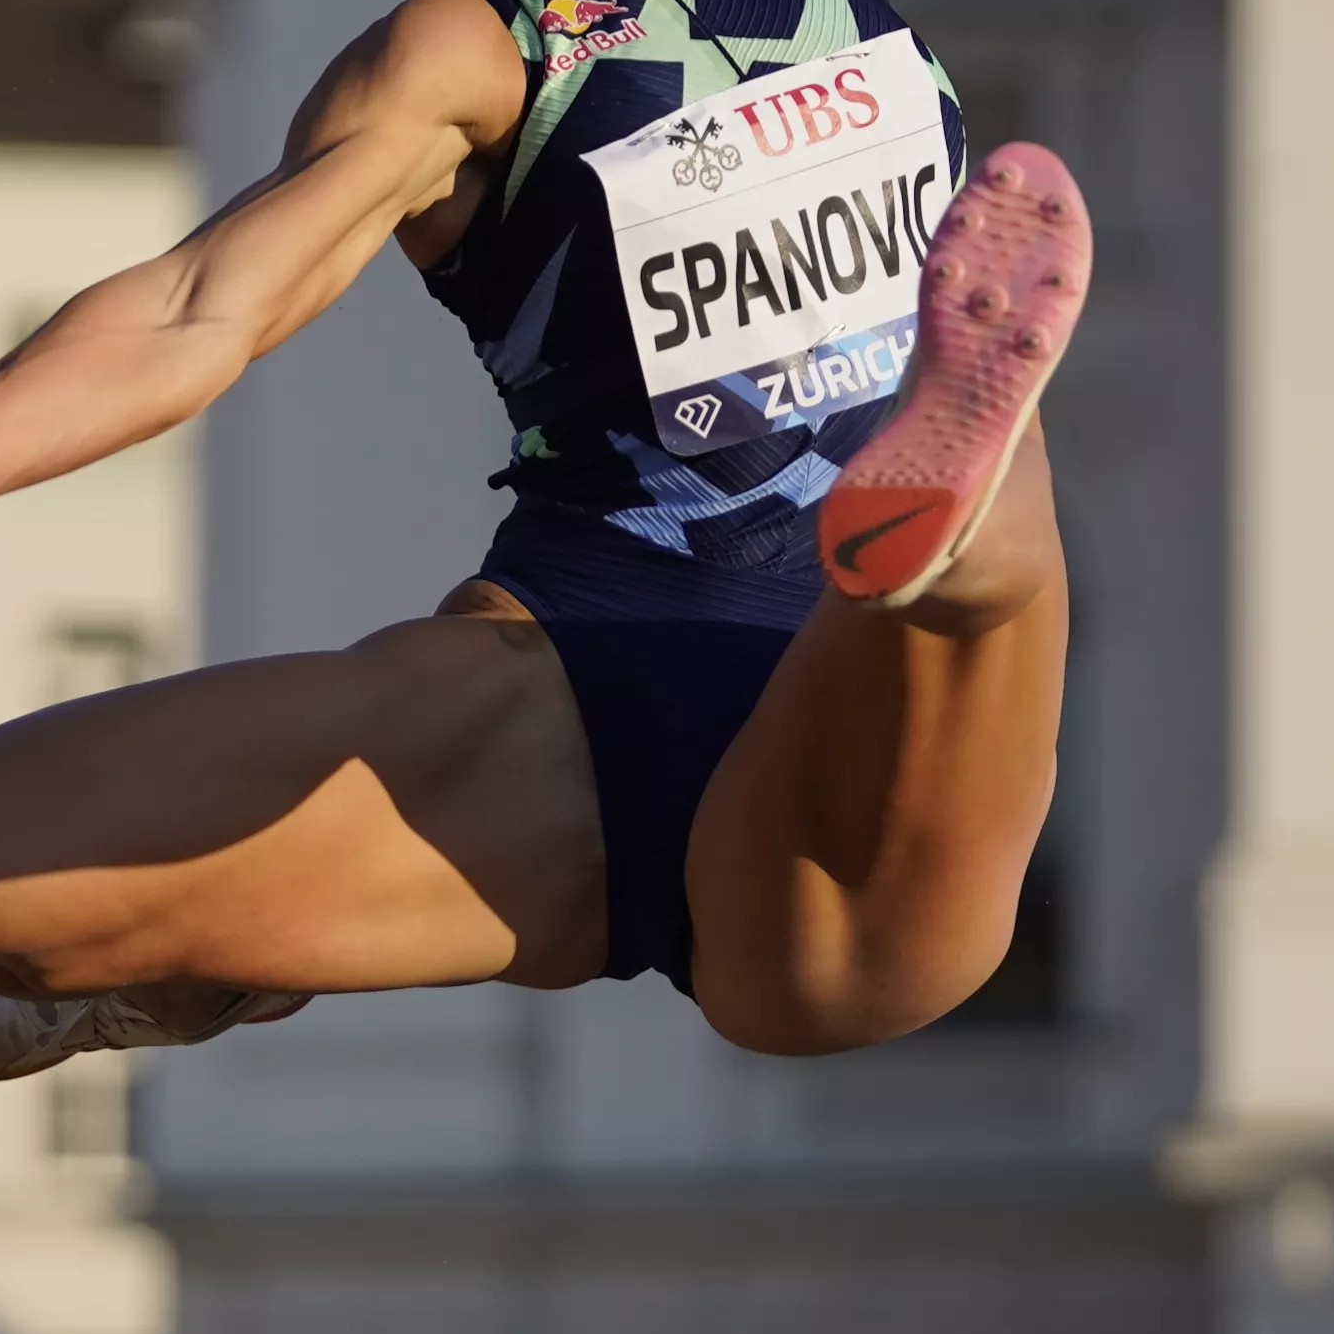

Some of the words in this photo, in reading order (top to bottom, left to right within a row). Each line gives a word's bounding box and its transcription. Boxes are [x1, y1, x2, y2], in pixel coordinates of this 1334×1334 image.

[544, 38, 595, 80] Red
[586, 18, 648, 51] Bull
[733, 68, 880, 157] UBS
[757, 328, 916, 419] ZURICH
